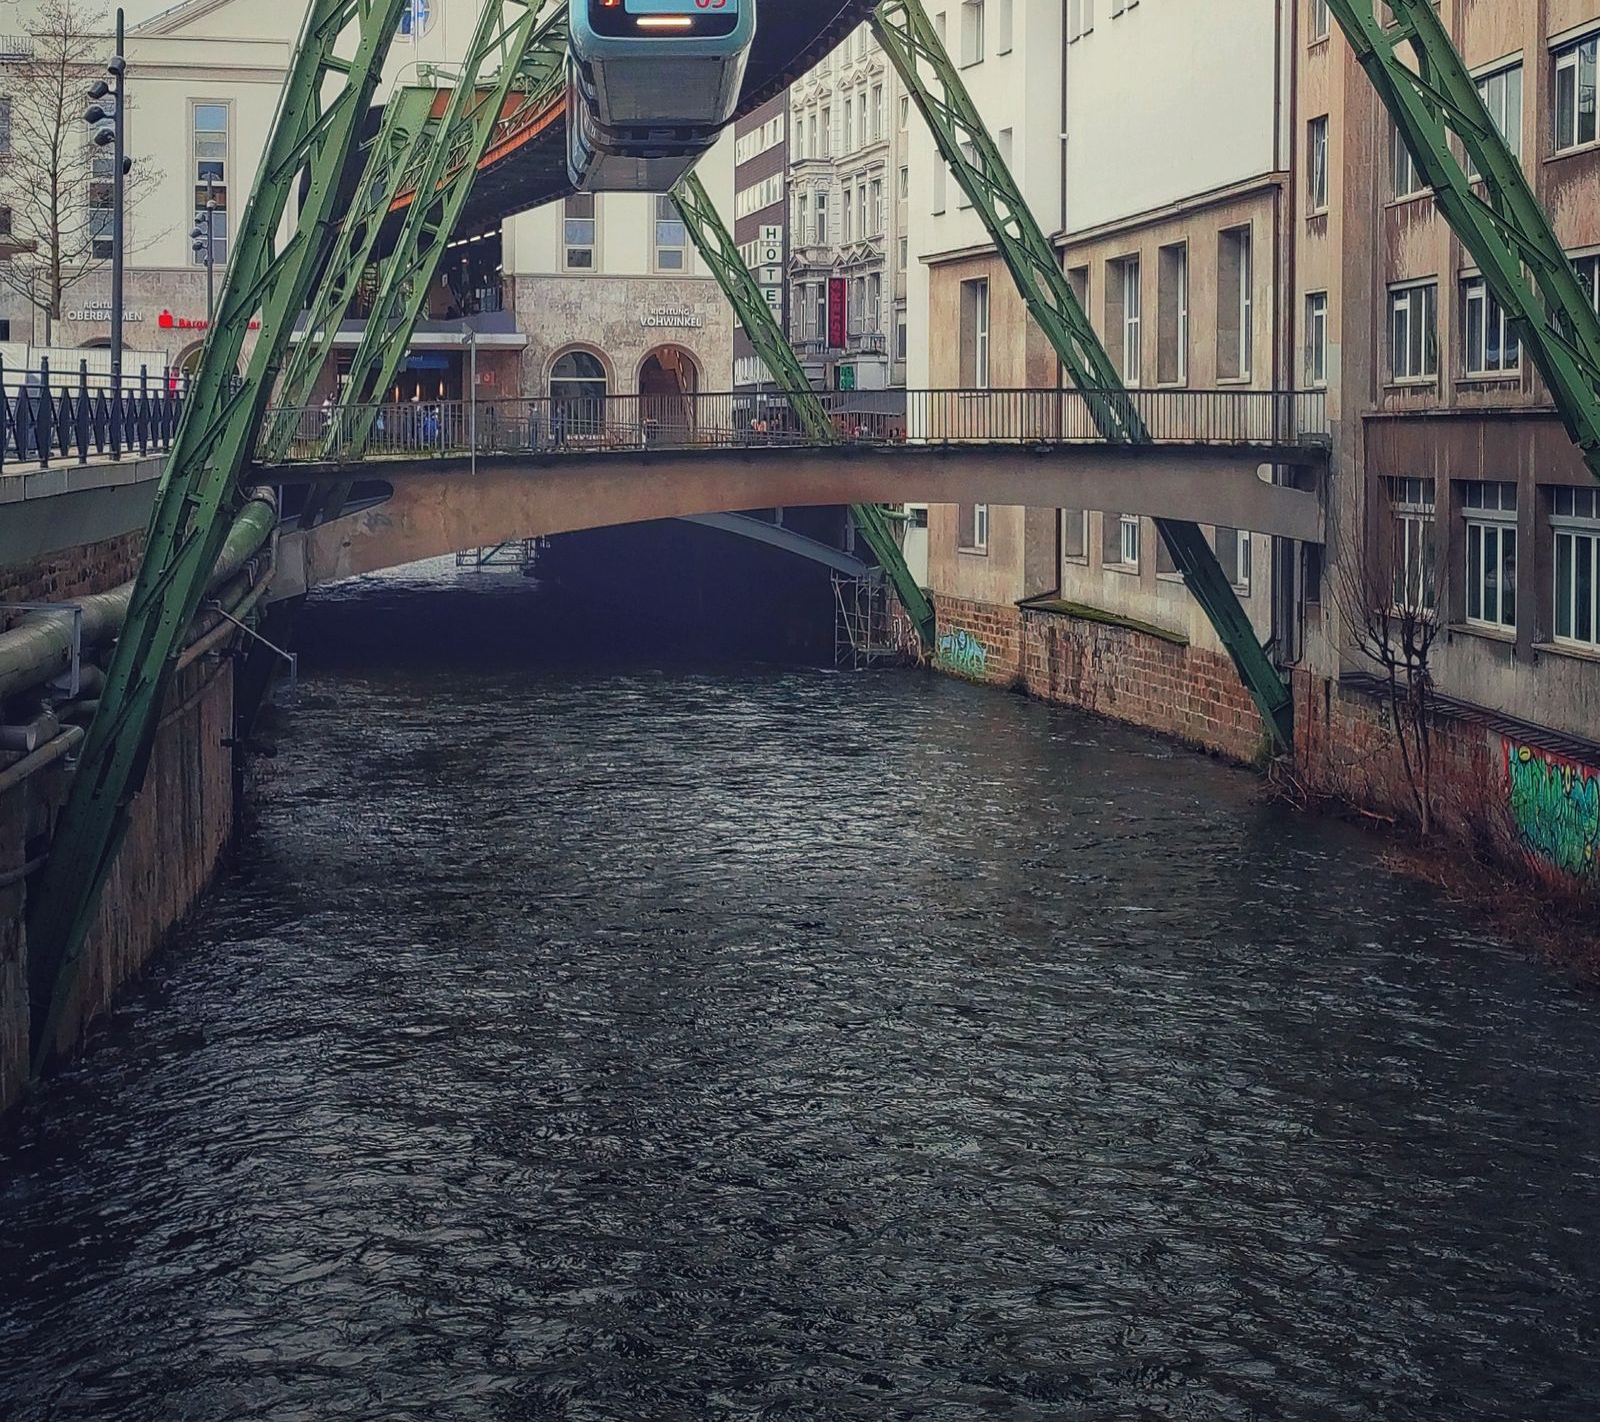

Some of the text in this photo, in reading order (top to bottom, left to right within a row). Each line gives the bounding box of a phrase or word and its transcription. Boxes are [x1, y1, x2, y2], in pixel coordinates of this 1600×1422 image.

[766, 227, 777, 302] HOTE
[83, 300, 126, 310] RICHTU
[67, 310, 143, 321] OBERBAMEN
[651, 307, 690, 316] RICHTUNG
[640, 317, 702, 327] VOHWINKEL
